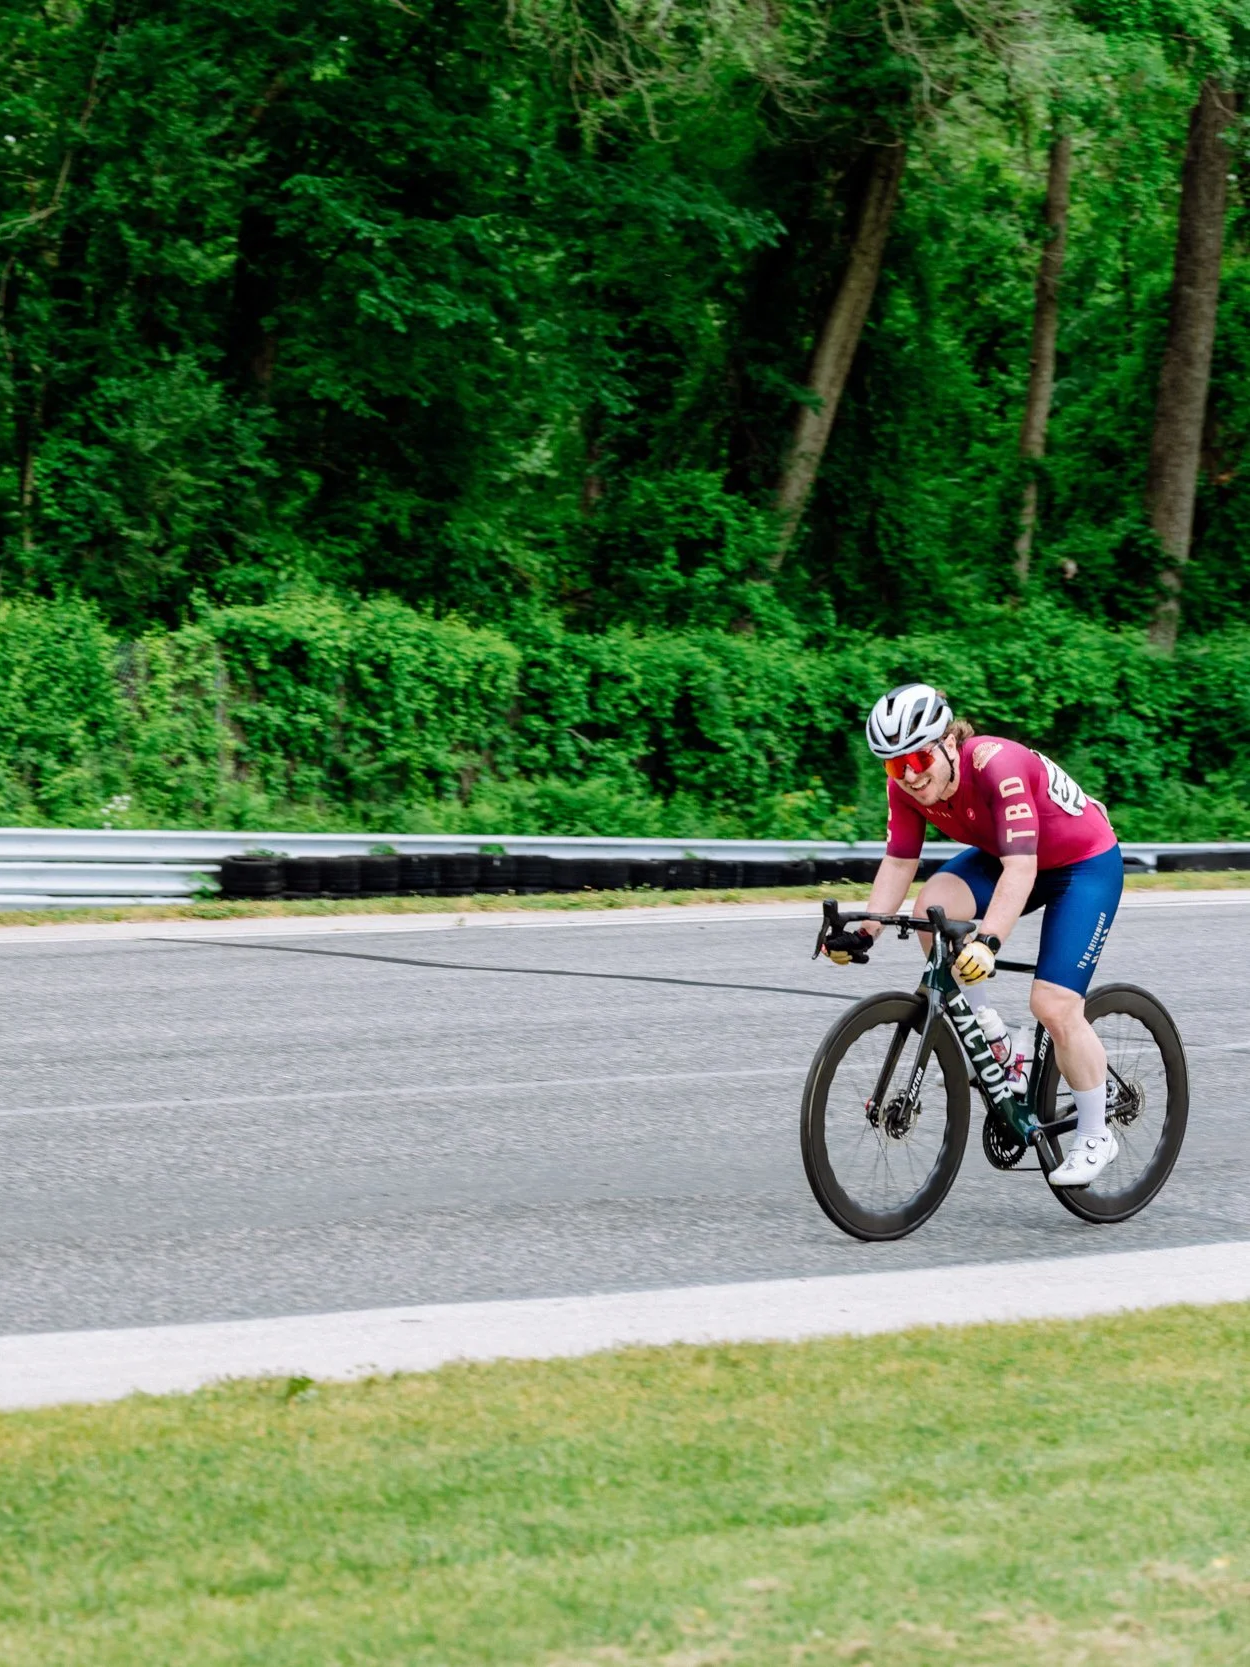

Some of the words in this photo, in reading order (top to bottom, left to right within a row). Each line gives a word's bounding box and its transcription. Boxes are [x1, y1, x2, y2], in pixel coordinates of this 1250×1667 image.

[999, 776, 1037, 843] TBD
[1077, 960, 1087, 970] TO
[1082, 951, 1092, 961] BE
[1087, 911, 1107, 952] DETERMINED
[948, 992, 1015, 1105] FACTOR
[909, 1066, 924, 1102] FACTOR
